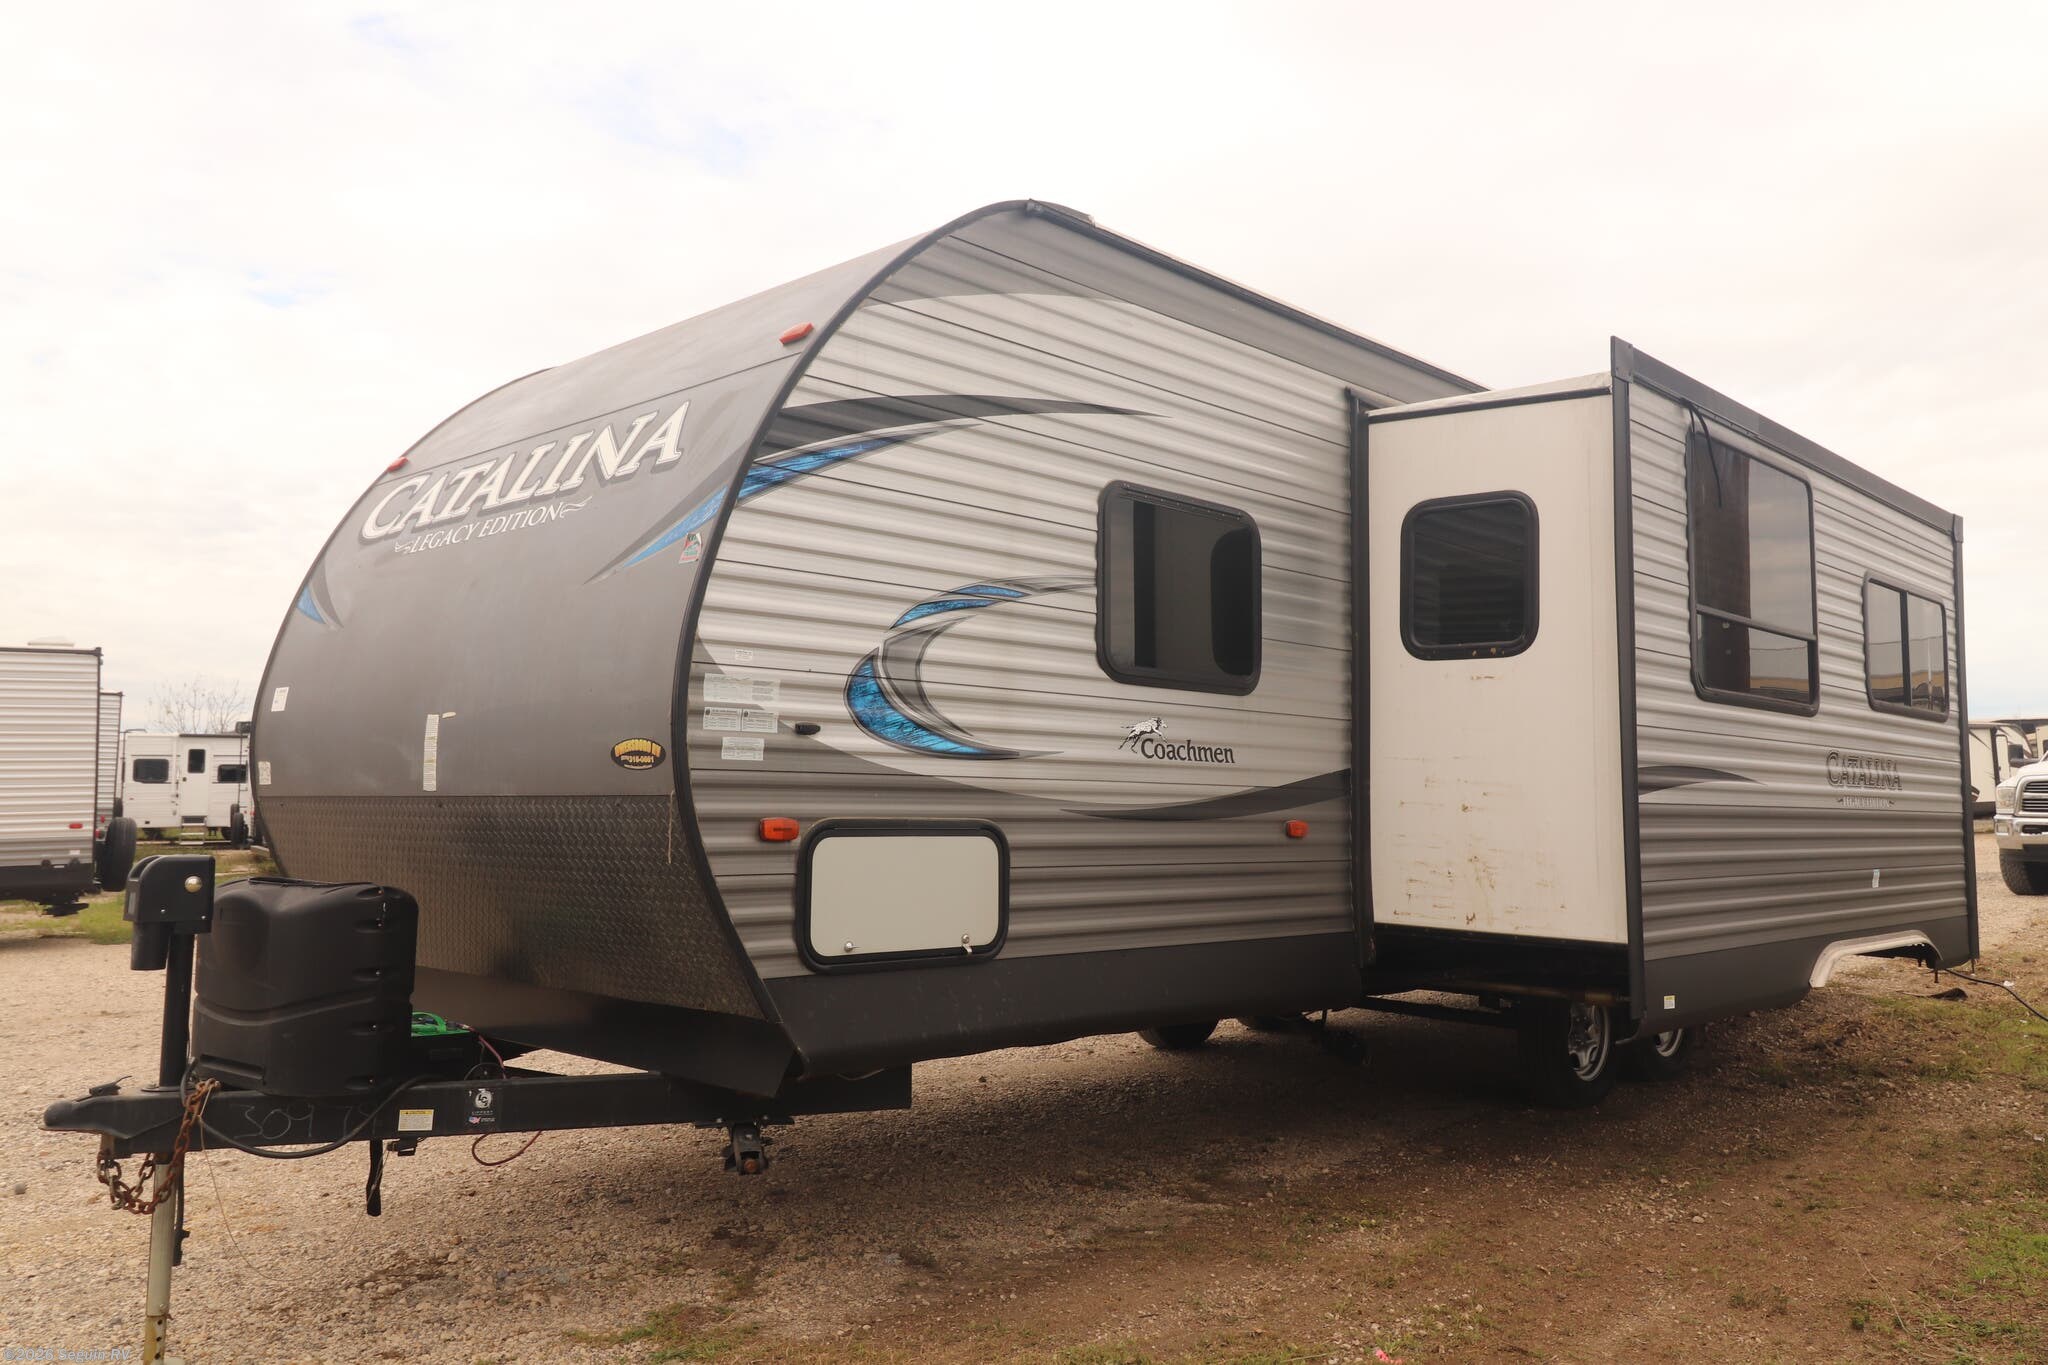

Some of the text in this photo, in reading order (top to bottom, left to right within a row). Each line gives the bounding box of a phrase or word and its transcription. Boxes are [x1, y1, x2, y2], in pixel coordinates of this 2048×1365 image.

[360, 401, 690, 542] CATALINA
[409, 502, 561, 554] LEGACY EDITION
[1140, 737, 1236, 764] Coachmen
